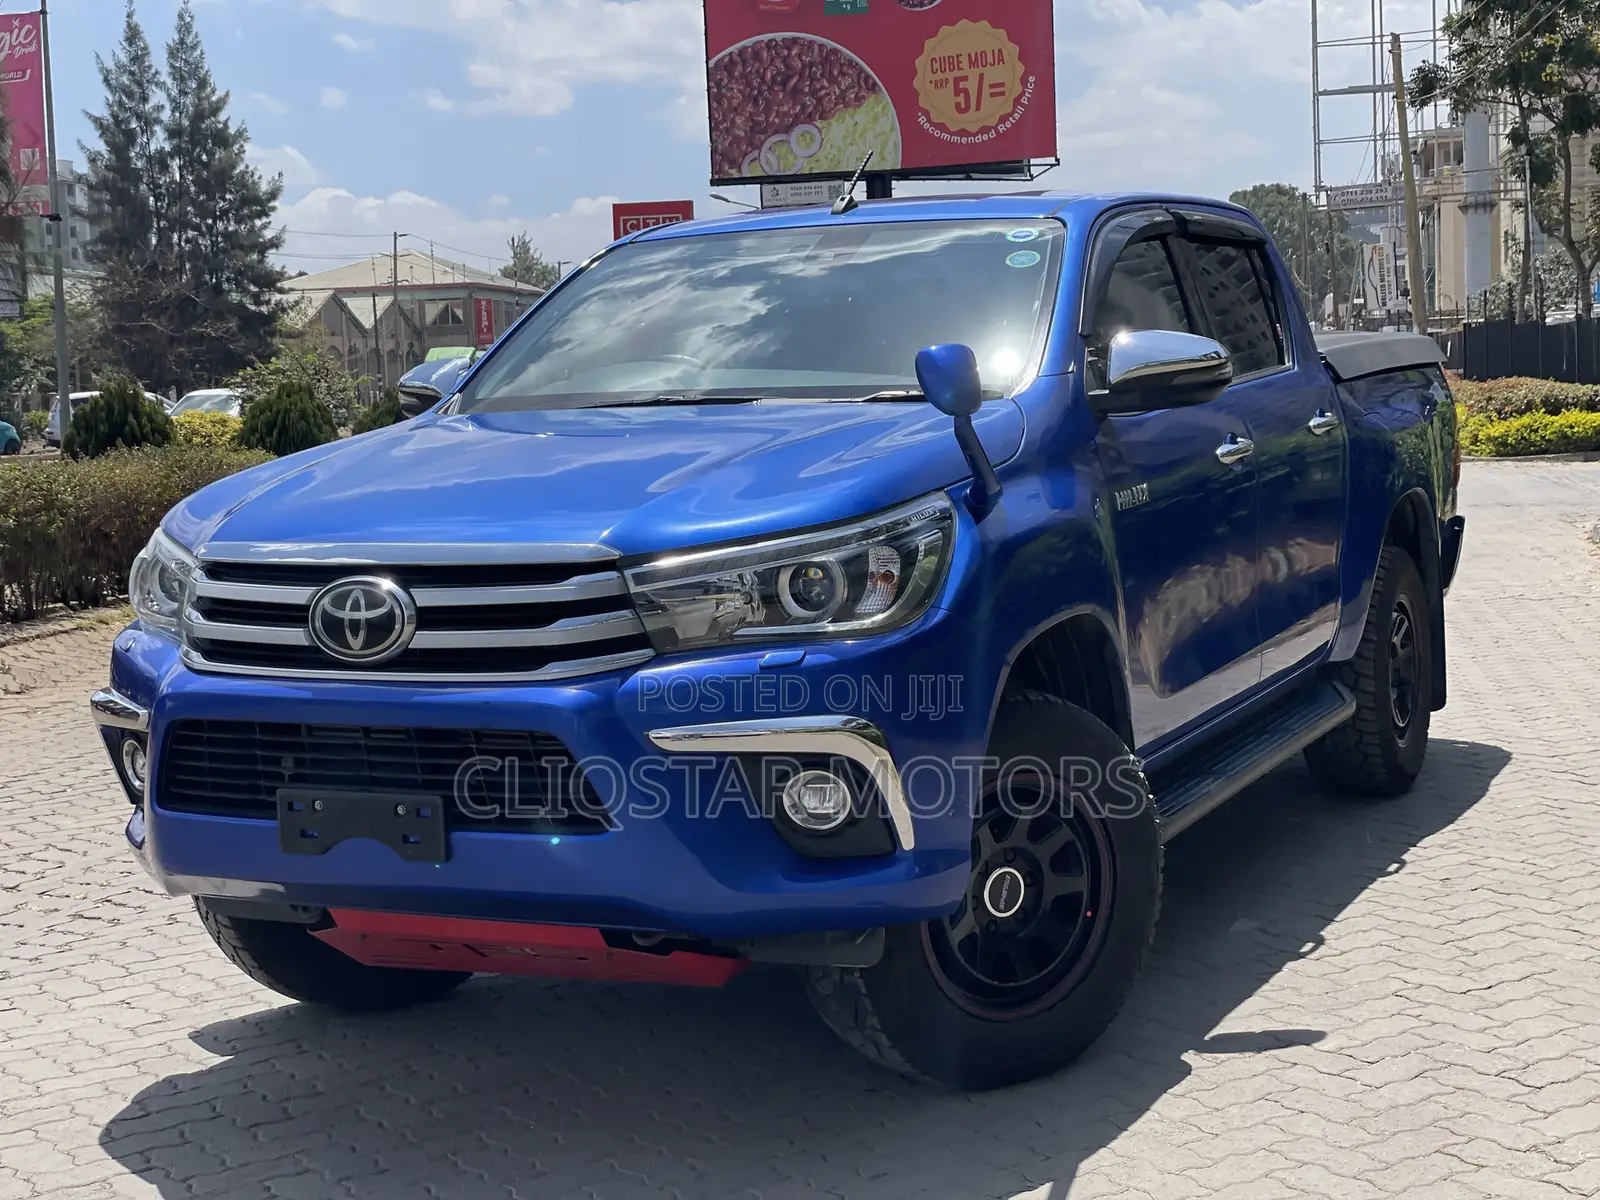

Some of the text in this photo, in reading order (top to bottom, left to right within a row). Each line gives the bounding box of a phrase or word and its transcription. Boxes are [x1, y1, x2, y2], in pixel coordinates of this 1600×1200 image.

[13, 39, 39, 59] Drink
[930, 48, 1006, 75] CUBE MOJA
[953, 72, 1006, 115] 5/=
[997, 105, 1025, 134] Retail
[1021, 75, 1036, 105] Price
[1377, 246, 1385, 257] LTD
[1378, 257, 1386, 283] MOTORS
[911, 506, 936, 522] HILUX
